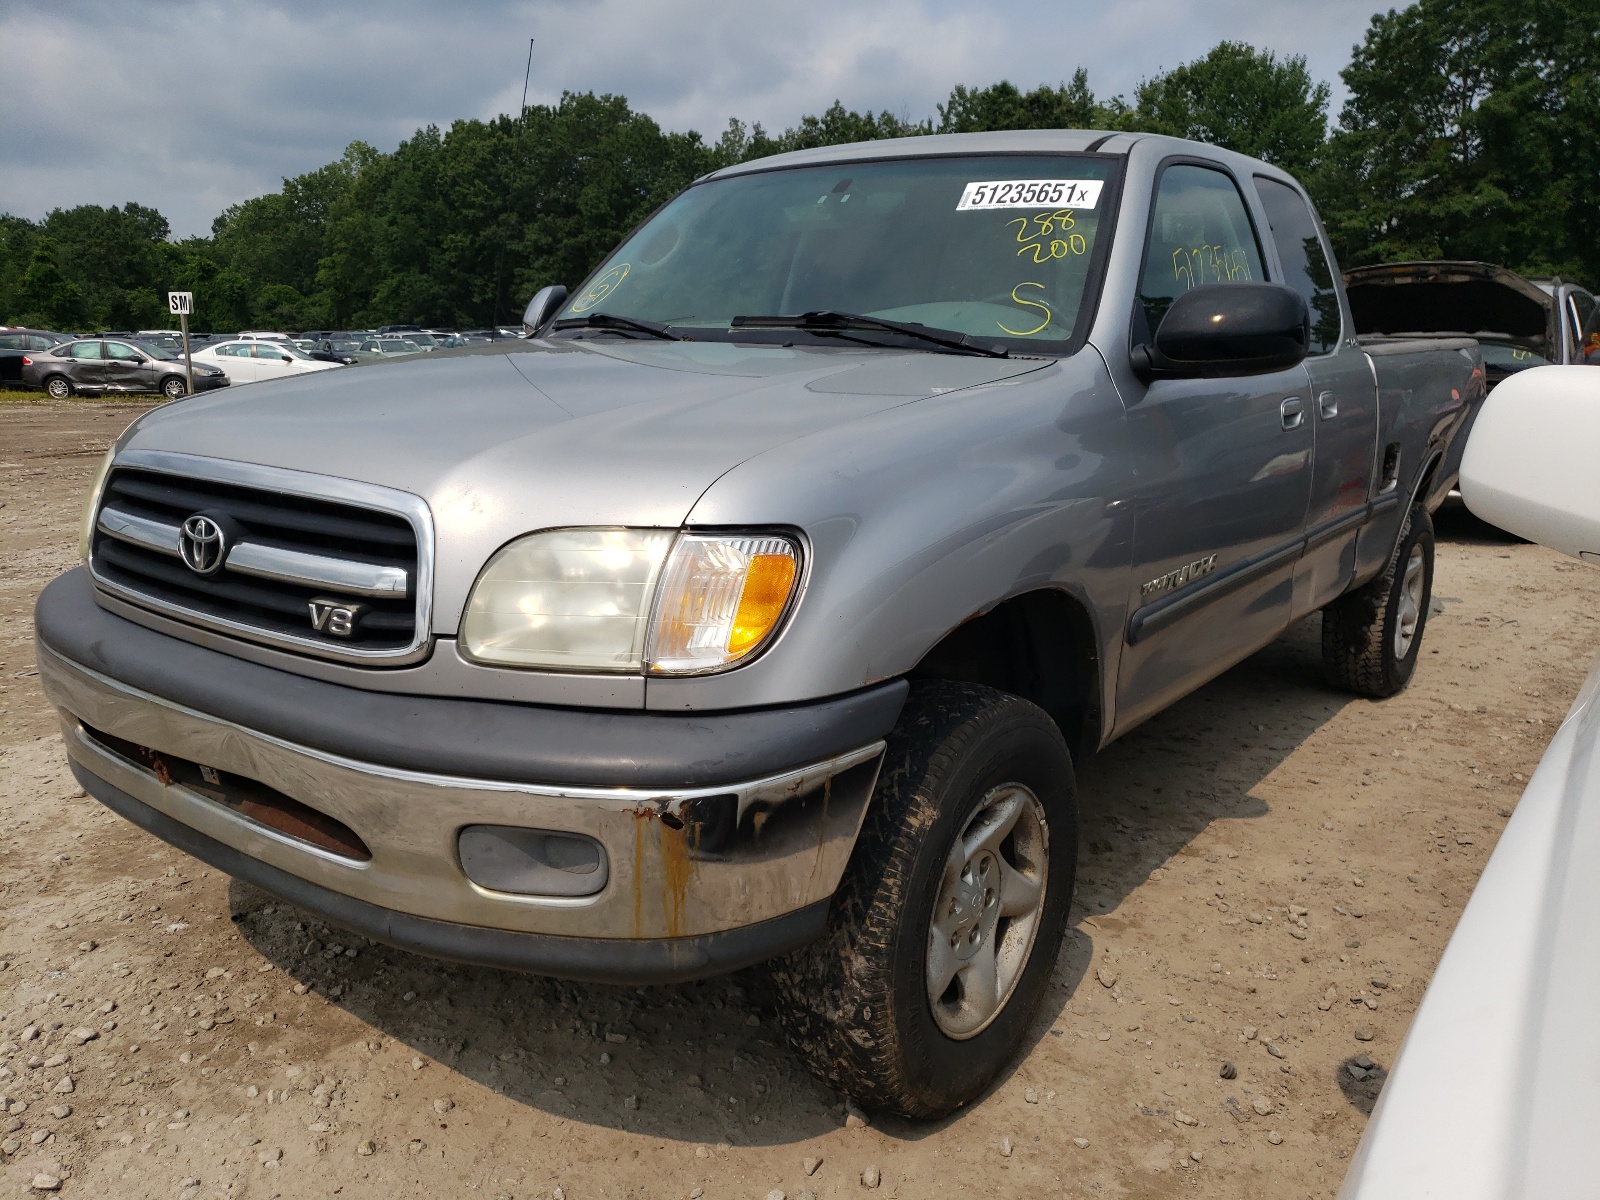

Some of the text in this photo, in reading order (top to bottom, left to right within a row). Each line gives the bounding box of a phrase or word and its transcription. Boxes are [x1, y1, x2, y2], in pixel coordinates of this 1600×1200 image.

[1005, 209, 1075, 242] 288
[1017, 234, 1086, 263] 200
[171, 295, 188, 311] SM
[308, 603, 353, 636] V8
